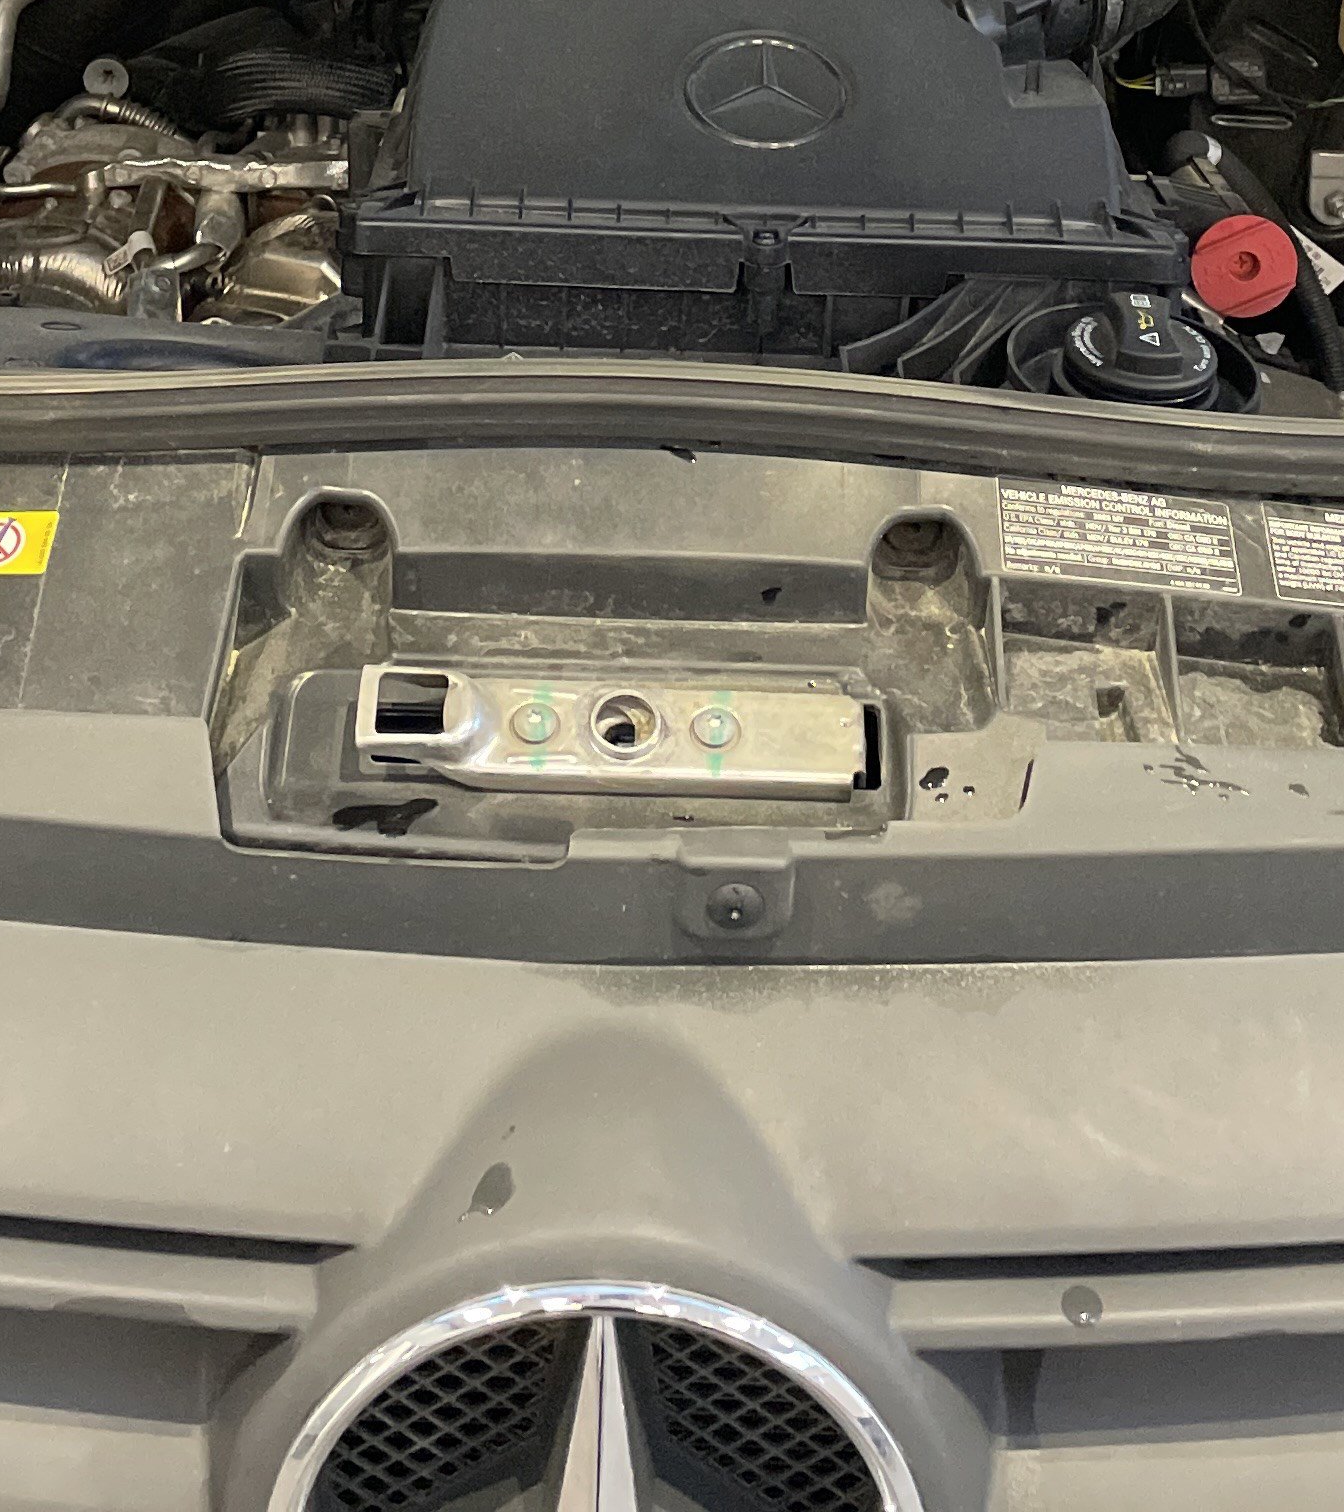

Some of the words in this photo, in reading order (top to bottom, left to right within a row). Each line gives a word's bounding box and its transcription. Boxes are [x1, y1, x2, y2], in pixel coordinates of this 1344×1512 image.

[1001, 488, 1047, 503] VEHICLE
[1047, 493, 1100, 510] EMISSION
[1102, 500, 1153, 516] CONTROL
[1154, 507, 1228, 526] INFORMATION
[1060, 484, 1150, 506] MERCEDES-BENZ
[1150, 496, 1167, 508] AG
